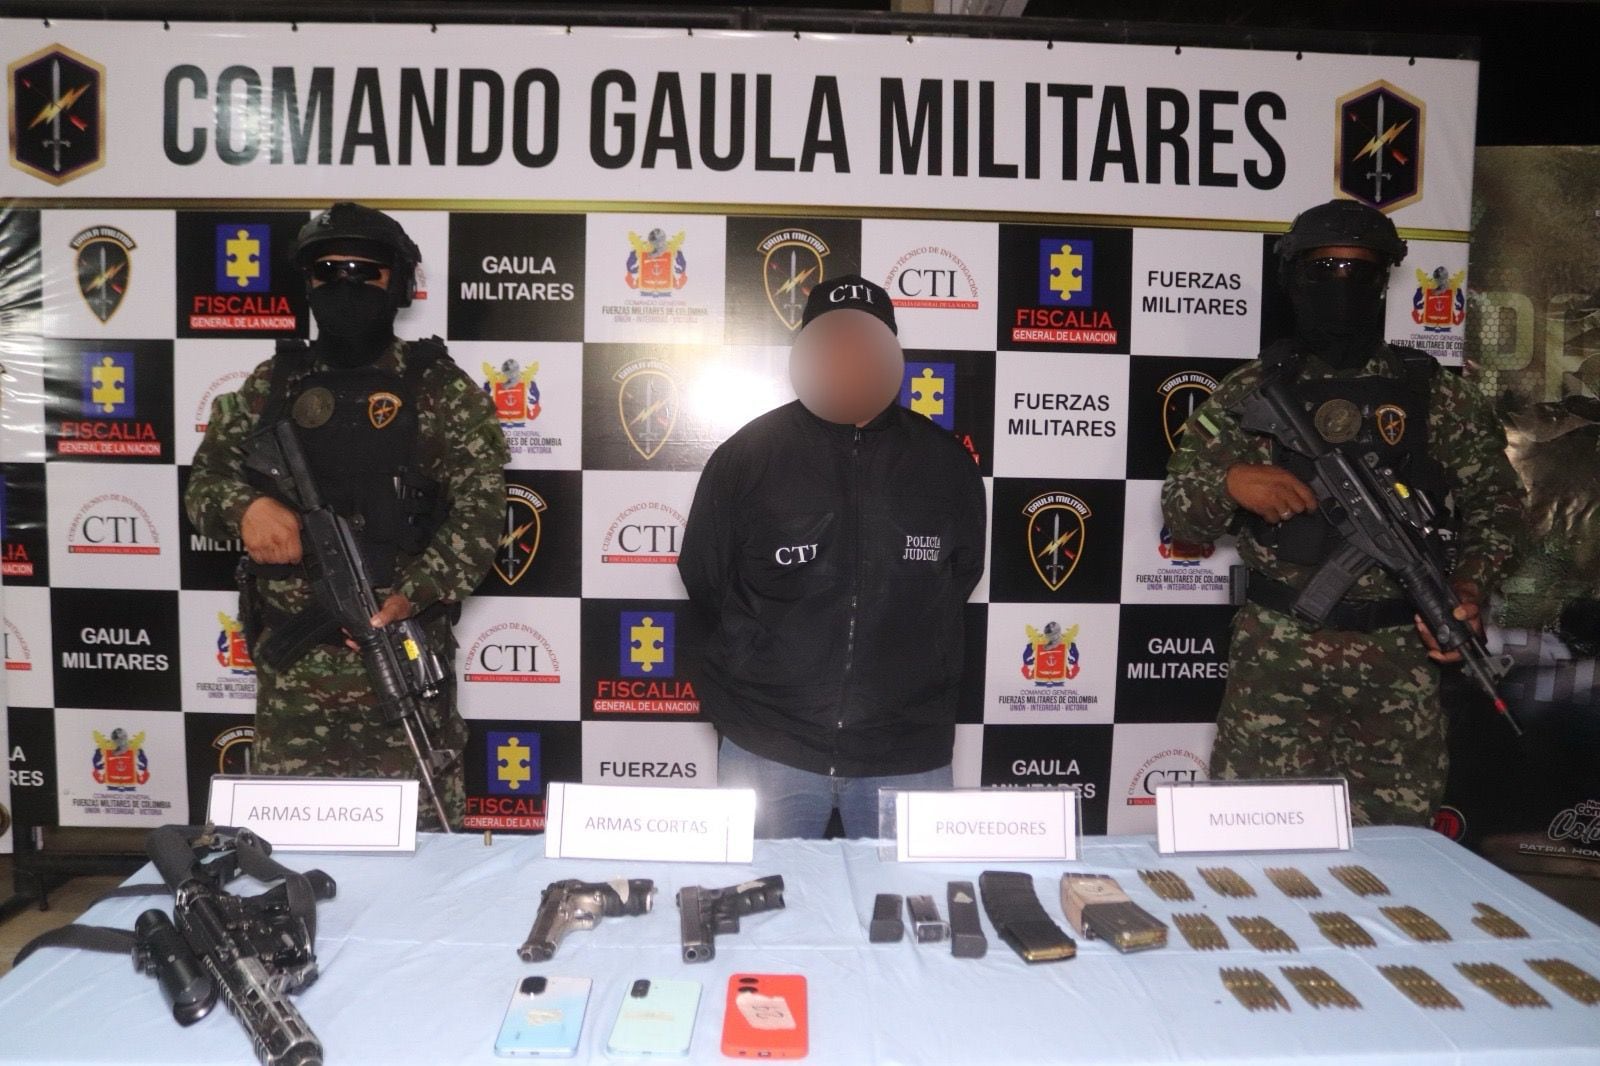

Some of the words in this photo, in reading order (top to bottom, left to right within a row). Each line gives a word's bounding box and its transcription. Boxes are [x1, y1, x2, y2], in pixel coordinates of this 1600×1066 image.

[163, 64, 560, 169] COMANDO
[590, 69, 851, 174] GAULA
[878, 76, 1288, 191] MILITARES
[762, 232, 791, 251] GAULA
[791, 231, 826, 253] MILITAR
[481, 255, 557, 275] GAULA
[898, 267, 958, 298] CTI
[1148, 270, 1242, 291] FUERZAS
[460, 282, 575, 301] MILITARES
[829, 283, 874, 305] CTI
[193, 295, 292, 314] FISCALIA
[1142, 296, 1248, 317] MILITARES
[190, 317, 233, 329] GENERAL
[234, 317, 247, 328] DE
[248, 317, 260, 328] LA
[1016, 308, 1113, 328] FISCALIA
[1012, 330, 1055, 341] GENERAL
[1056, 331, 1069, 341] DE
[1069, 331, 1081, 341] LA
[1082, 332, 1117, 343] NACION
[1162, 374, 1189, 392] GAULA
[1189, 374, 1217, 390] MILITA
[1013, 392, 1111, 412] FUERZAS
[61, 421, 157, 440] FISCALIA
[1008, 418, 1117, 437] MILITARES
[520, 438, 528, 446] DE
[529, 438, 562, 447] COLOMBIA
[1027, 494, 1055, 513] GAULA
[1055, 494, 1088, 515] MILITAR
[82, 515, 139, 544] CTI
[617, 523, 679, 553] CTI
[775, 543, 819, 566] CTI
[1136, 574, 1162, 583] FUERZAS
[1163, 575, 1194, 584] MILITARES
[1194, 575, 1203, 584] DE
[1203, 575, 1230, 584] COLOMBI
[80, 627, 151, 646] GAULA
[1147, 637, 1216, 656] GAULA
[61, 652, 170, 672] MILITARES
[480, 644, 539, 673] CTI
[1126, 662, 1230, 680] MILITARES
[597, 681, 695, 699] FISCALIA
[998, 695, 1026, 704] FUERZAS
[1026, 696, 1058, 704] MILITARES
[1058, 696, 1067, 704] DE
[1067, 696, 1098, 704] COLOMBIA
[594, 701, 637, 711] GENERAL
[638, 701, 651, 711] DE
[651, 702, 664, 711] LA
[665, 702, 700, 712] NACION
[599, 761, 697, 778] FUERZAS
[1011, 759, 1081, 776] GAULA
[1143, 769, 1199, 796] CTI
[247, 805, 312, 822] ARMAS
[316, 806, 384, 823] LARGAS
[466, 797, 546, 815] FISCALI
[464, 816, 505, 827] GENERAL
[505, 817, 518, 828] DE
[519, 818, 532, 828] LA
[584, 816, 642, 833] ARMAS
[646, 817, 709, 835] CORTAS
[935, 820, 1047, 837] PROVEEDORES
[1208, 810, 1305, 828] MUNICIONES
[1519, 842, 1567, 853] PATRIA
[1571, 847, 1600, 857] HON
